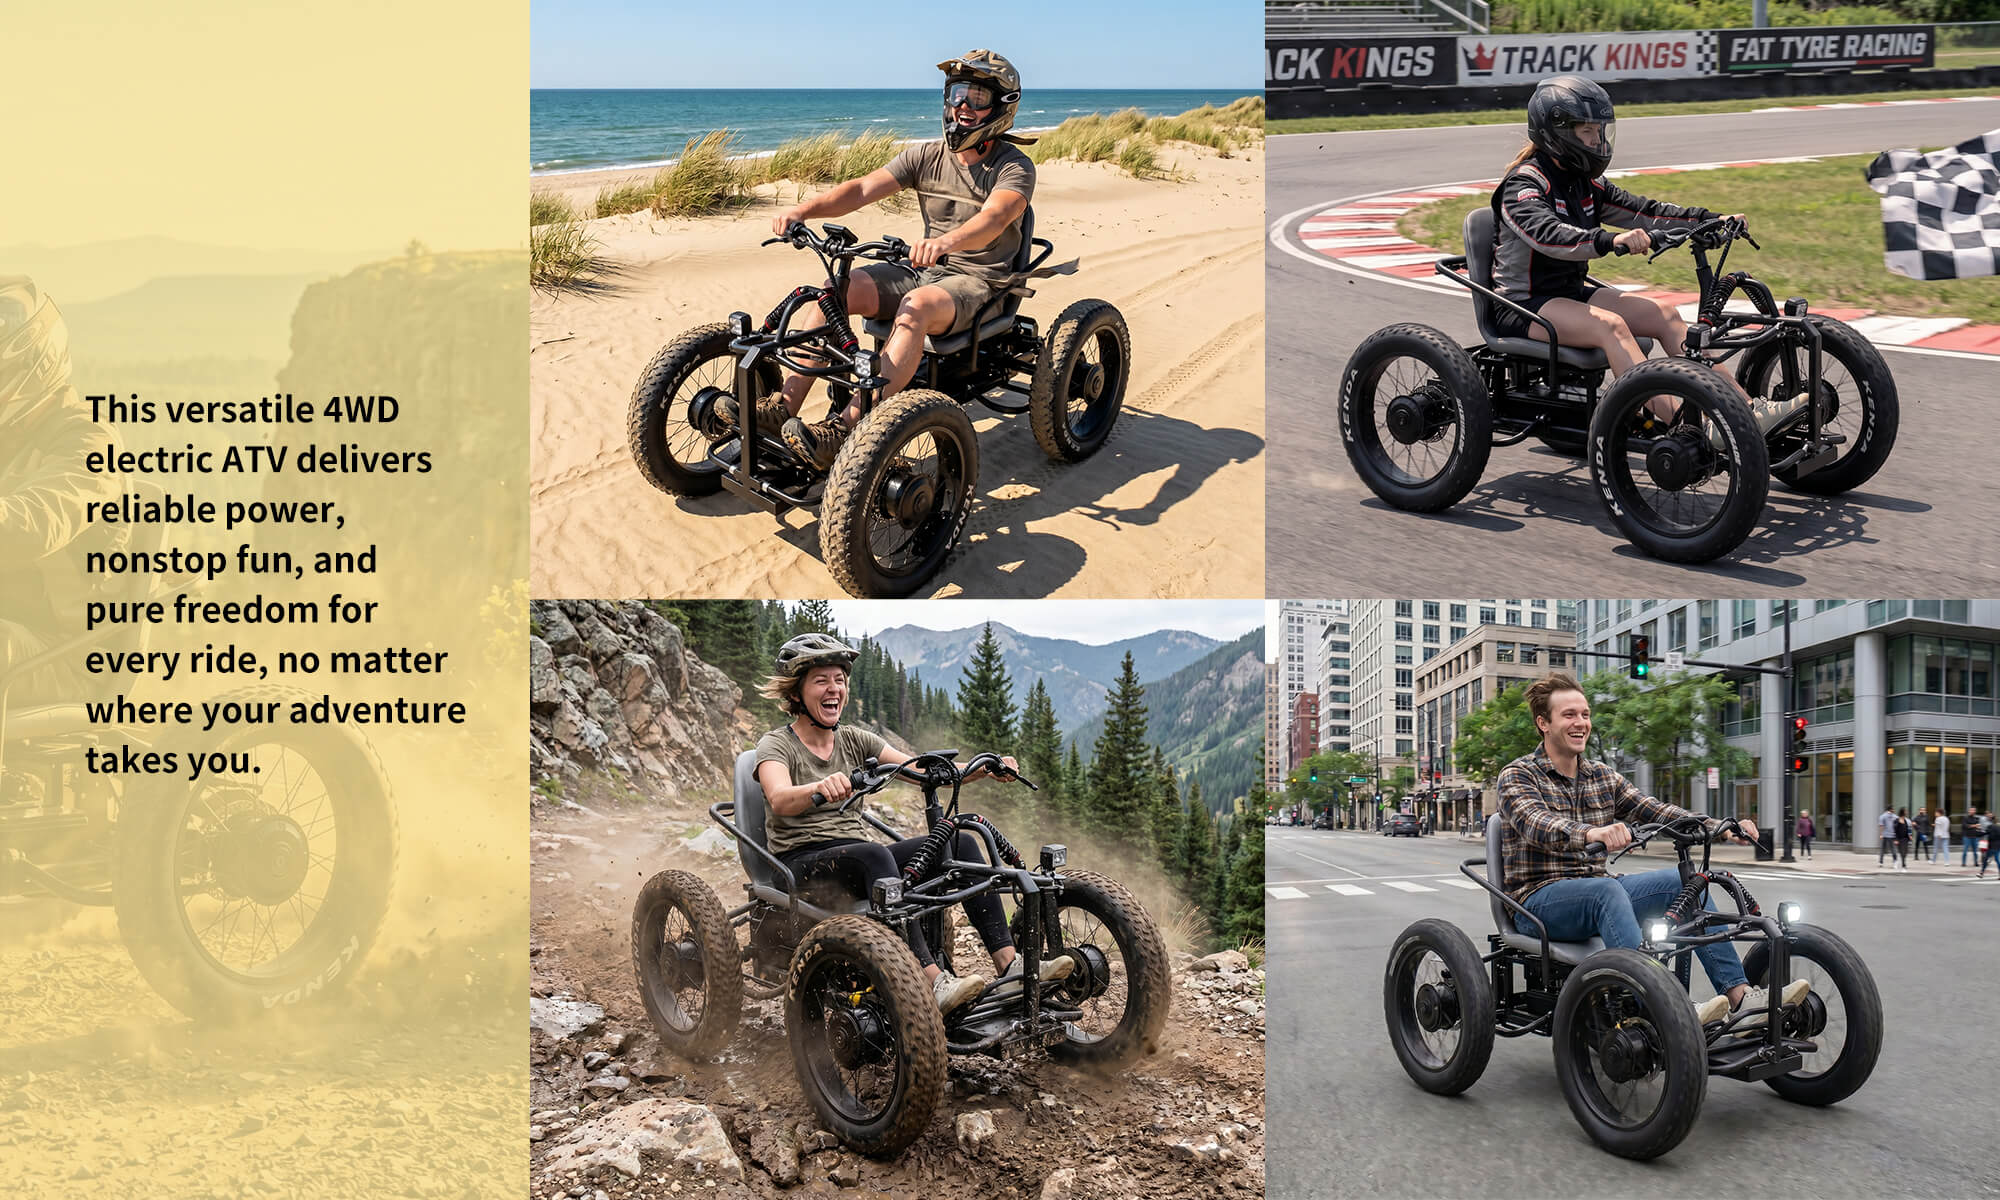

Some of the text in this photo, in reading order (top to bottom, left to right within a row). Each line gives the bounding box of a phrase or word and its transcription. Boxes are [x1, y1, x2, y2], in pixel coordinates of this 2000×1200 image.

[1330, 46, 1436, 79] KINGS
[1502, 41, 1689, 75] TRACK KINGS
[1729, 31, 1928, 62] FAT TYRE RACING
[1343, 369, 1359, 443] KENDA
[1860, 380, 1876, 453] KENDA
[1595, 436, 1625, 517] KENDA
[945, 484, 974, 550] KENDA
[262, 935, 360, 1009] KENDA
